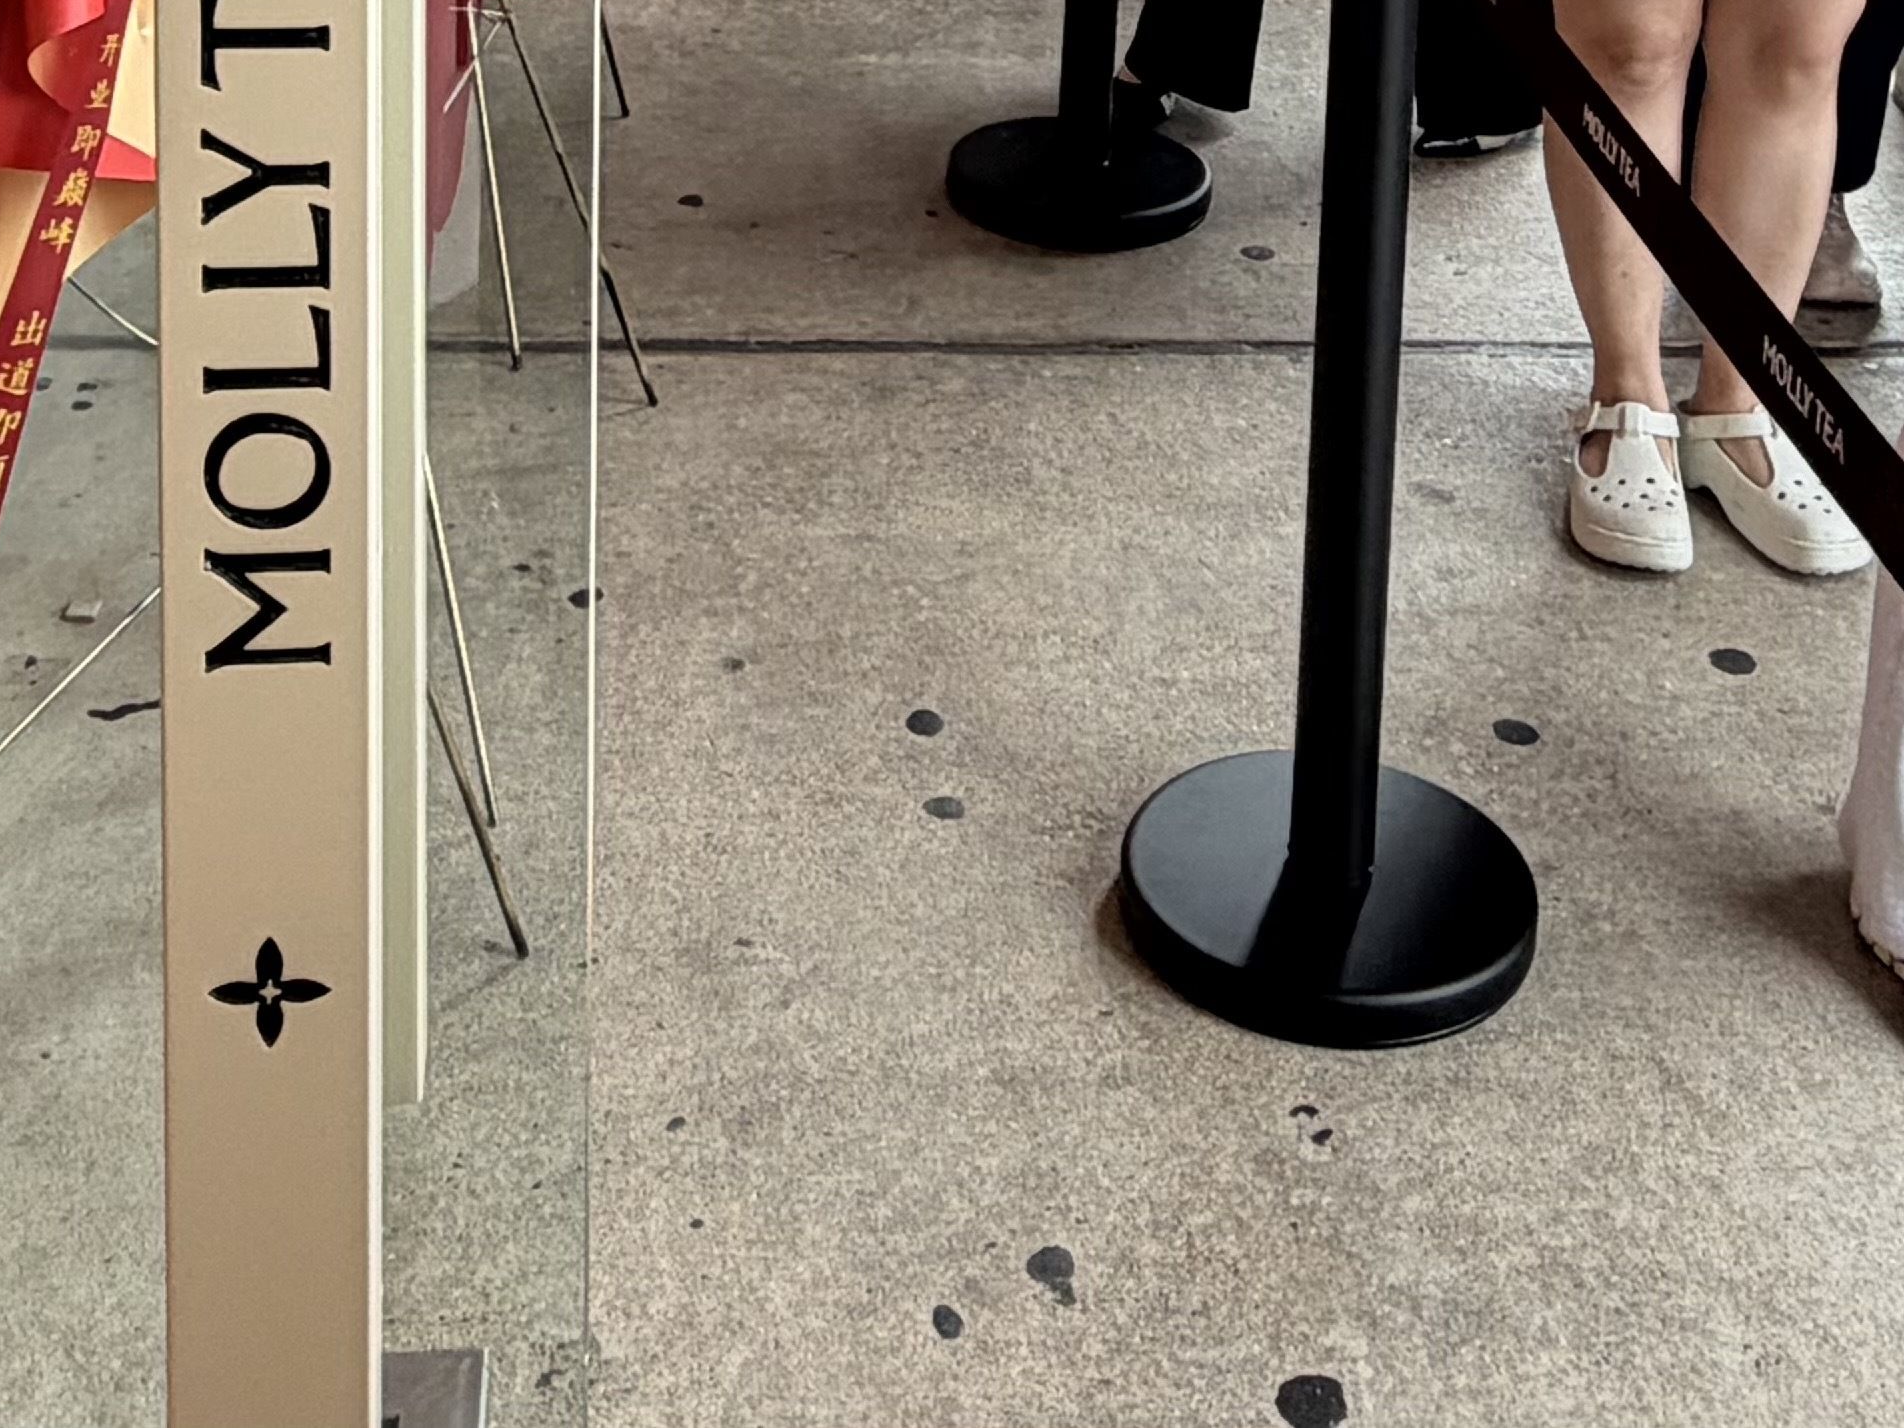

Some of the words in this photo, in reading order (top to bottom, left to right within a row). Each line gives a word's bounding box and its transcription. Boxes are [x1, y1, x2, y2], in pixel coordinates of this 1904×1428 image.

[1619, 145, 1640, 197] TEA
[200, 128, 333, 674] MOLLY
[1762, 334, 1814, 419] MOLLY
[1815, 398, 1845, 465] TEA
